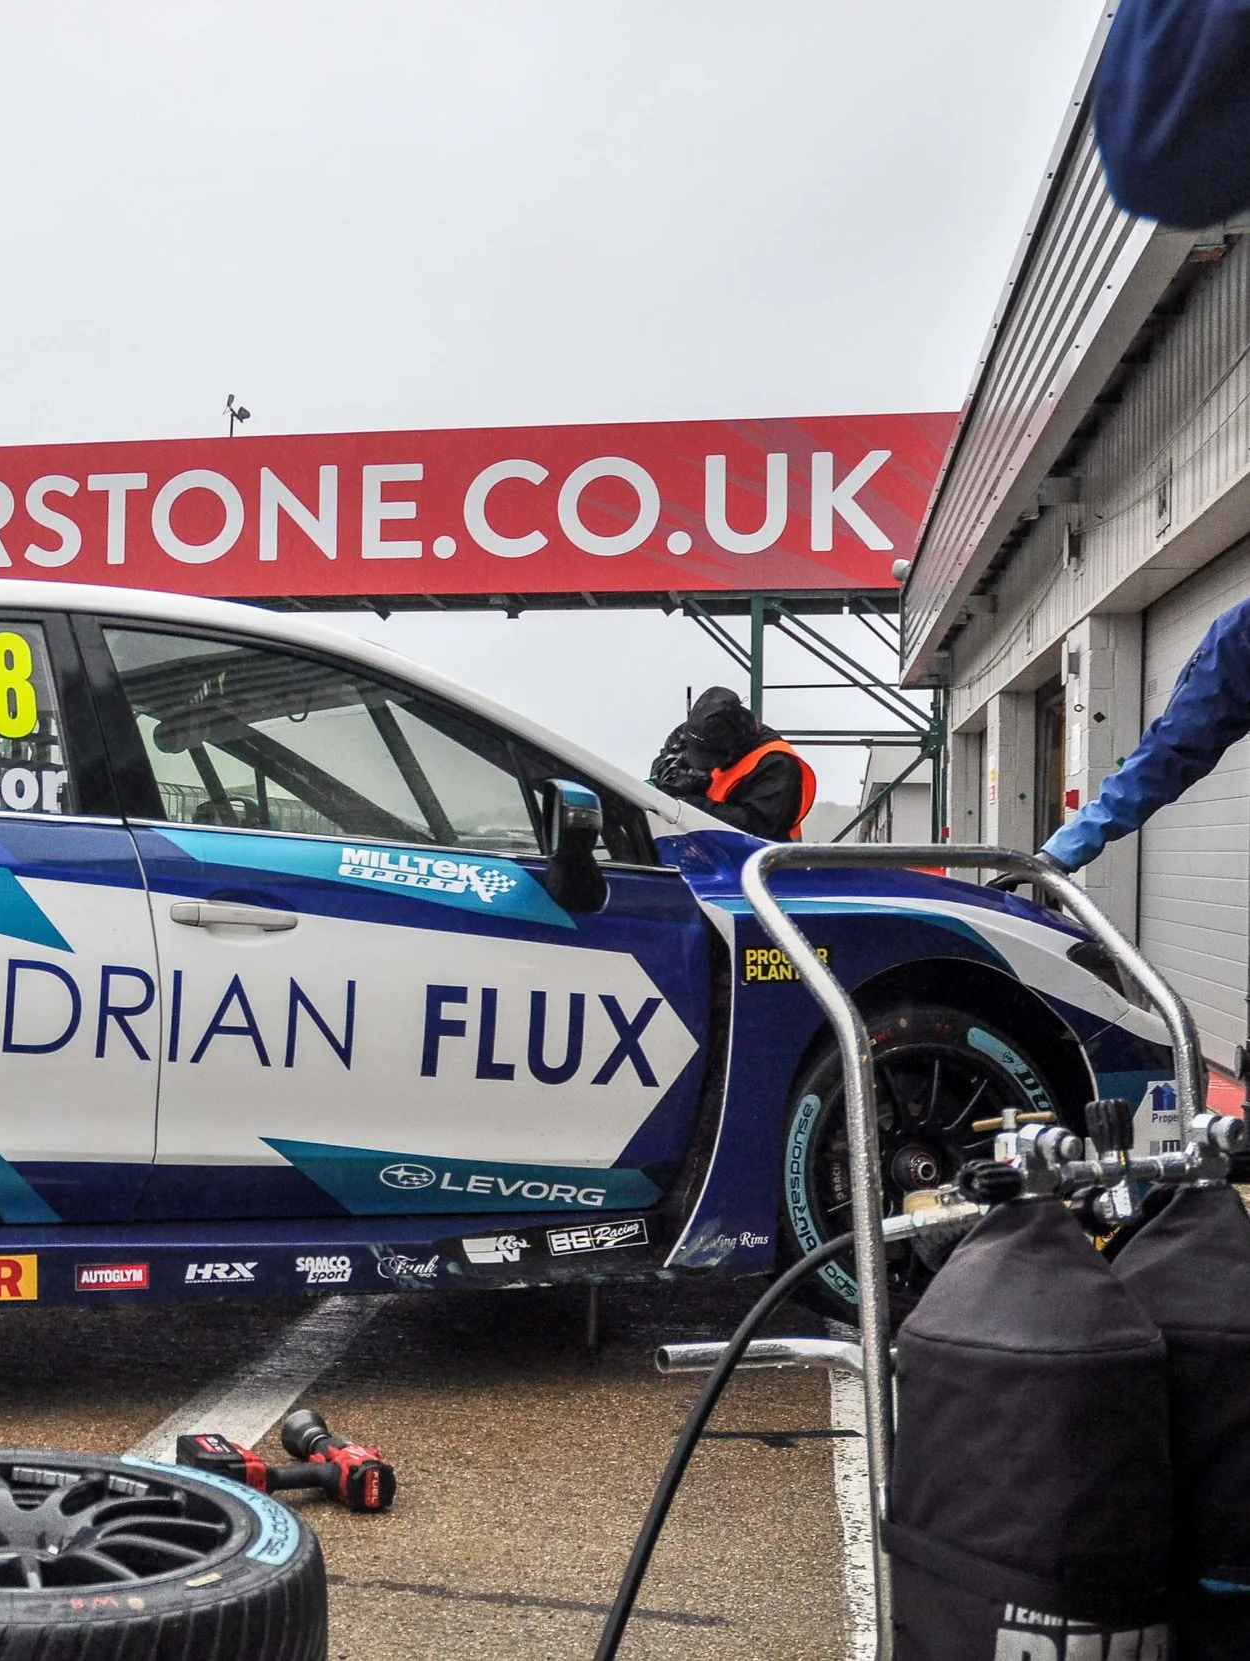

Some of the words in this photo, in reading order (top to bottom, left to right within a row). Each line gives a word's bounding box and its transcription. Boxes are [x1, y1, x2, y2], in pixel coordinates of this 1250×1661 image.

[349, 867, 449, 889] SPORT
[421, 984, 664, 1087] FLUX
[440, 1172, 607, 1207] LEVORG
[594, 1222, 641, 1247] Racing
[739, 1231, 769, 1248] Rims
[184, 1262, 258, 1280] HRX
[295, 1256, 351, 1272] SAMCO
[81, 1269, 144, 1284] AUTOGLYM
[310, 1270, 348, 1282] sport
[371, 1470, 381, 1504] FUEL
